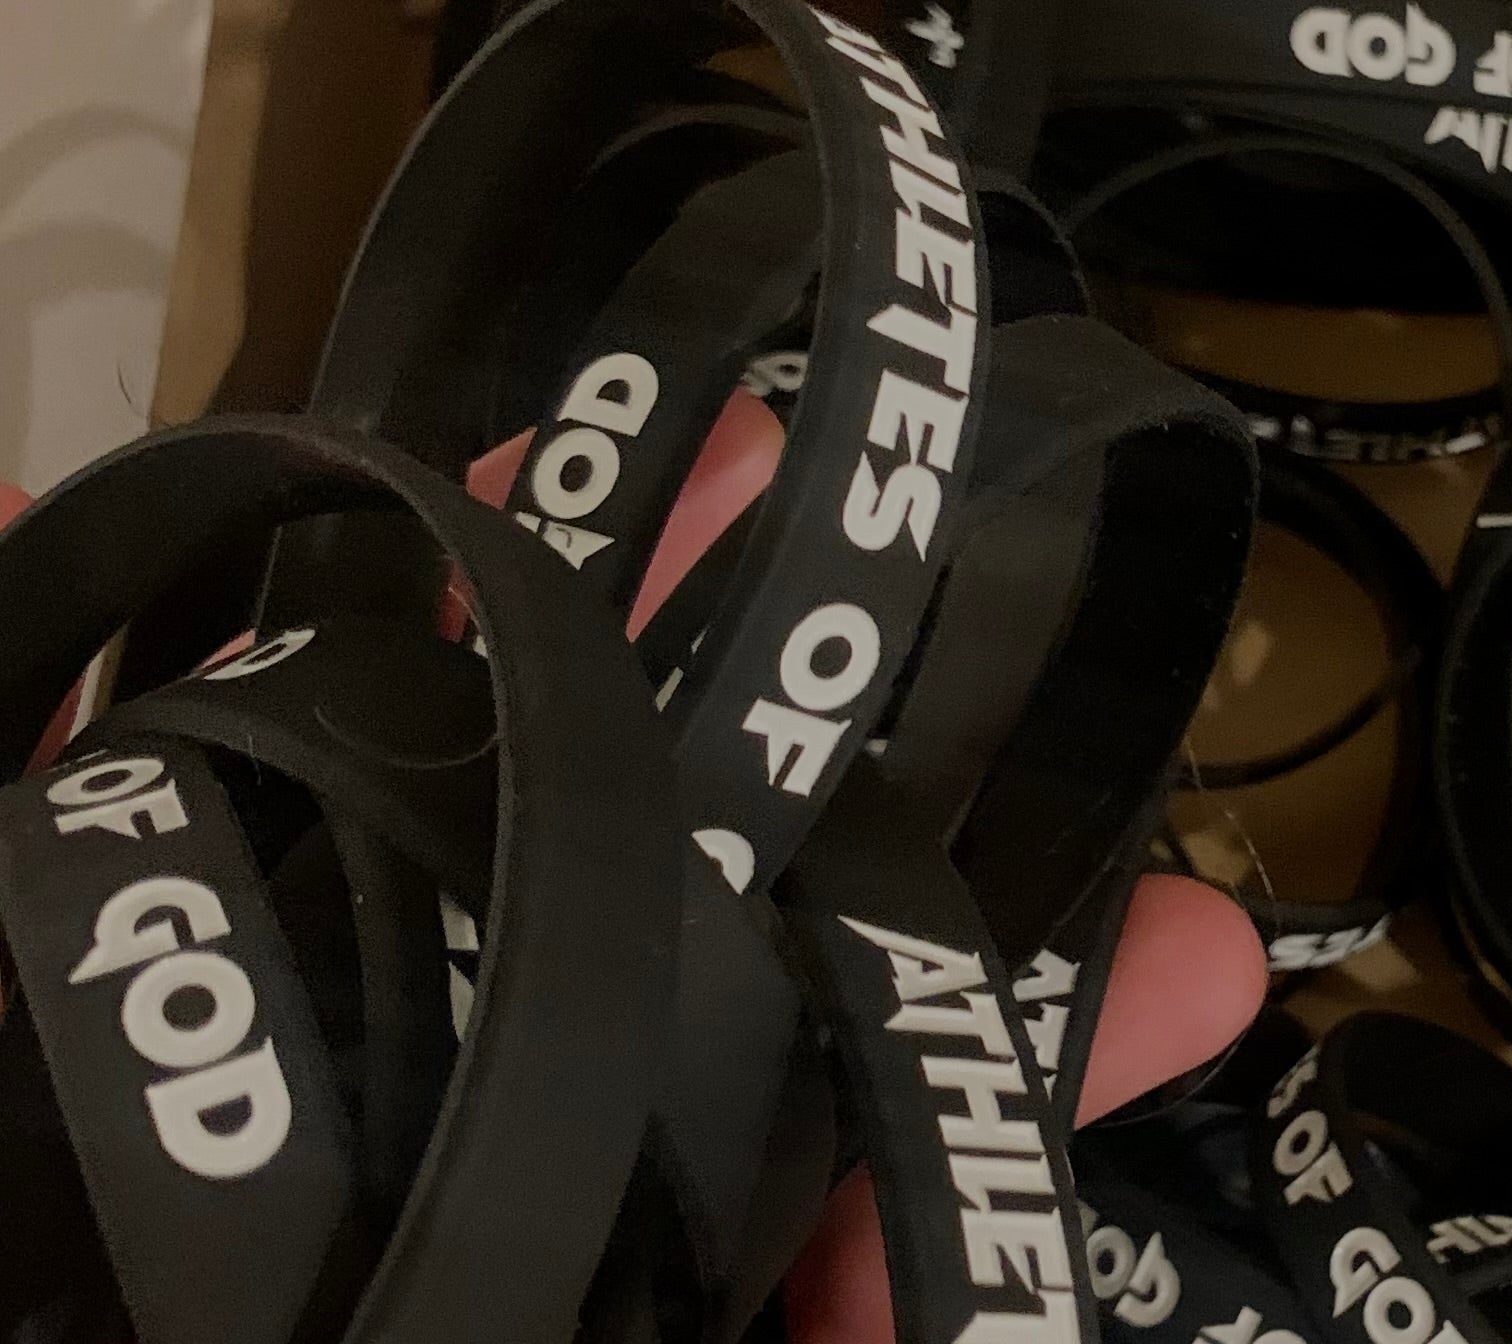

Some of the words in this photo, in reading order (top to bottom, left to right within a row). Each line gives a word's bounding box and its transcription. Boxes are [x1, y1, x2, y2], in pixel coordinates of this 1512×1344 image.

[1288, 1, 1457, 88] GOD
[742, 601, 881, 798] OF
[46, 756, 189, 840] OF
[67, 875, 293, 1181] GOD
[1272, 1108, 1354, 1206] OF
[1077, 1199, 1181, 1328] GO
